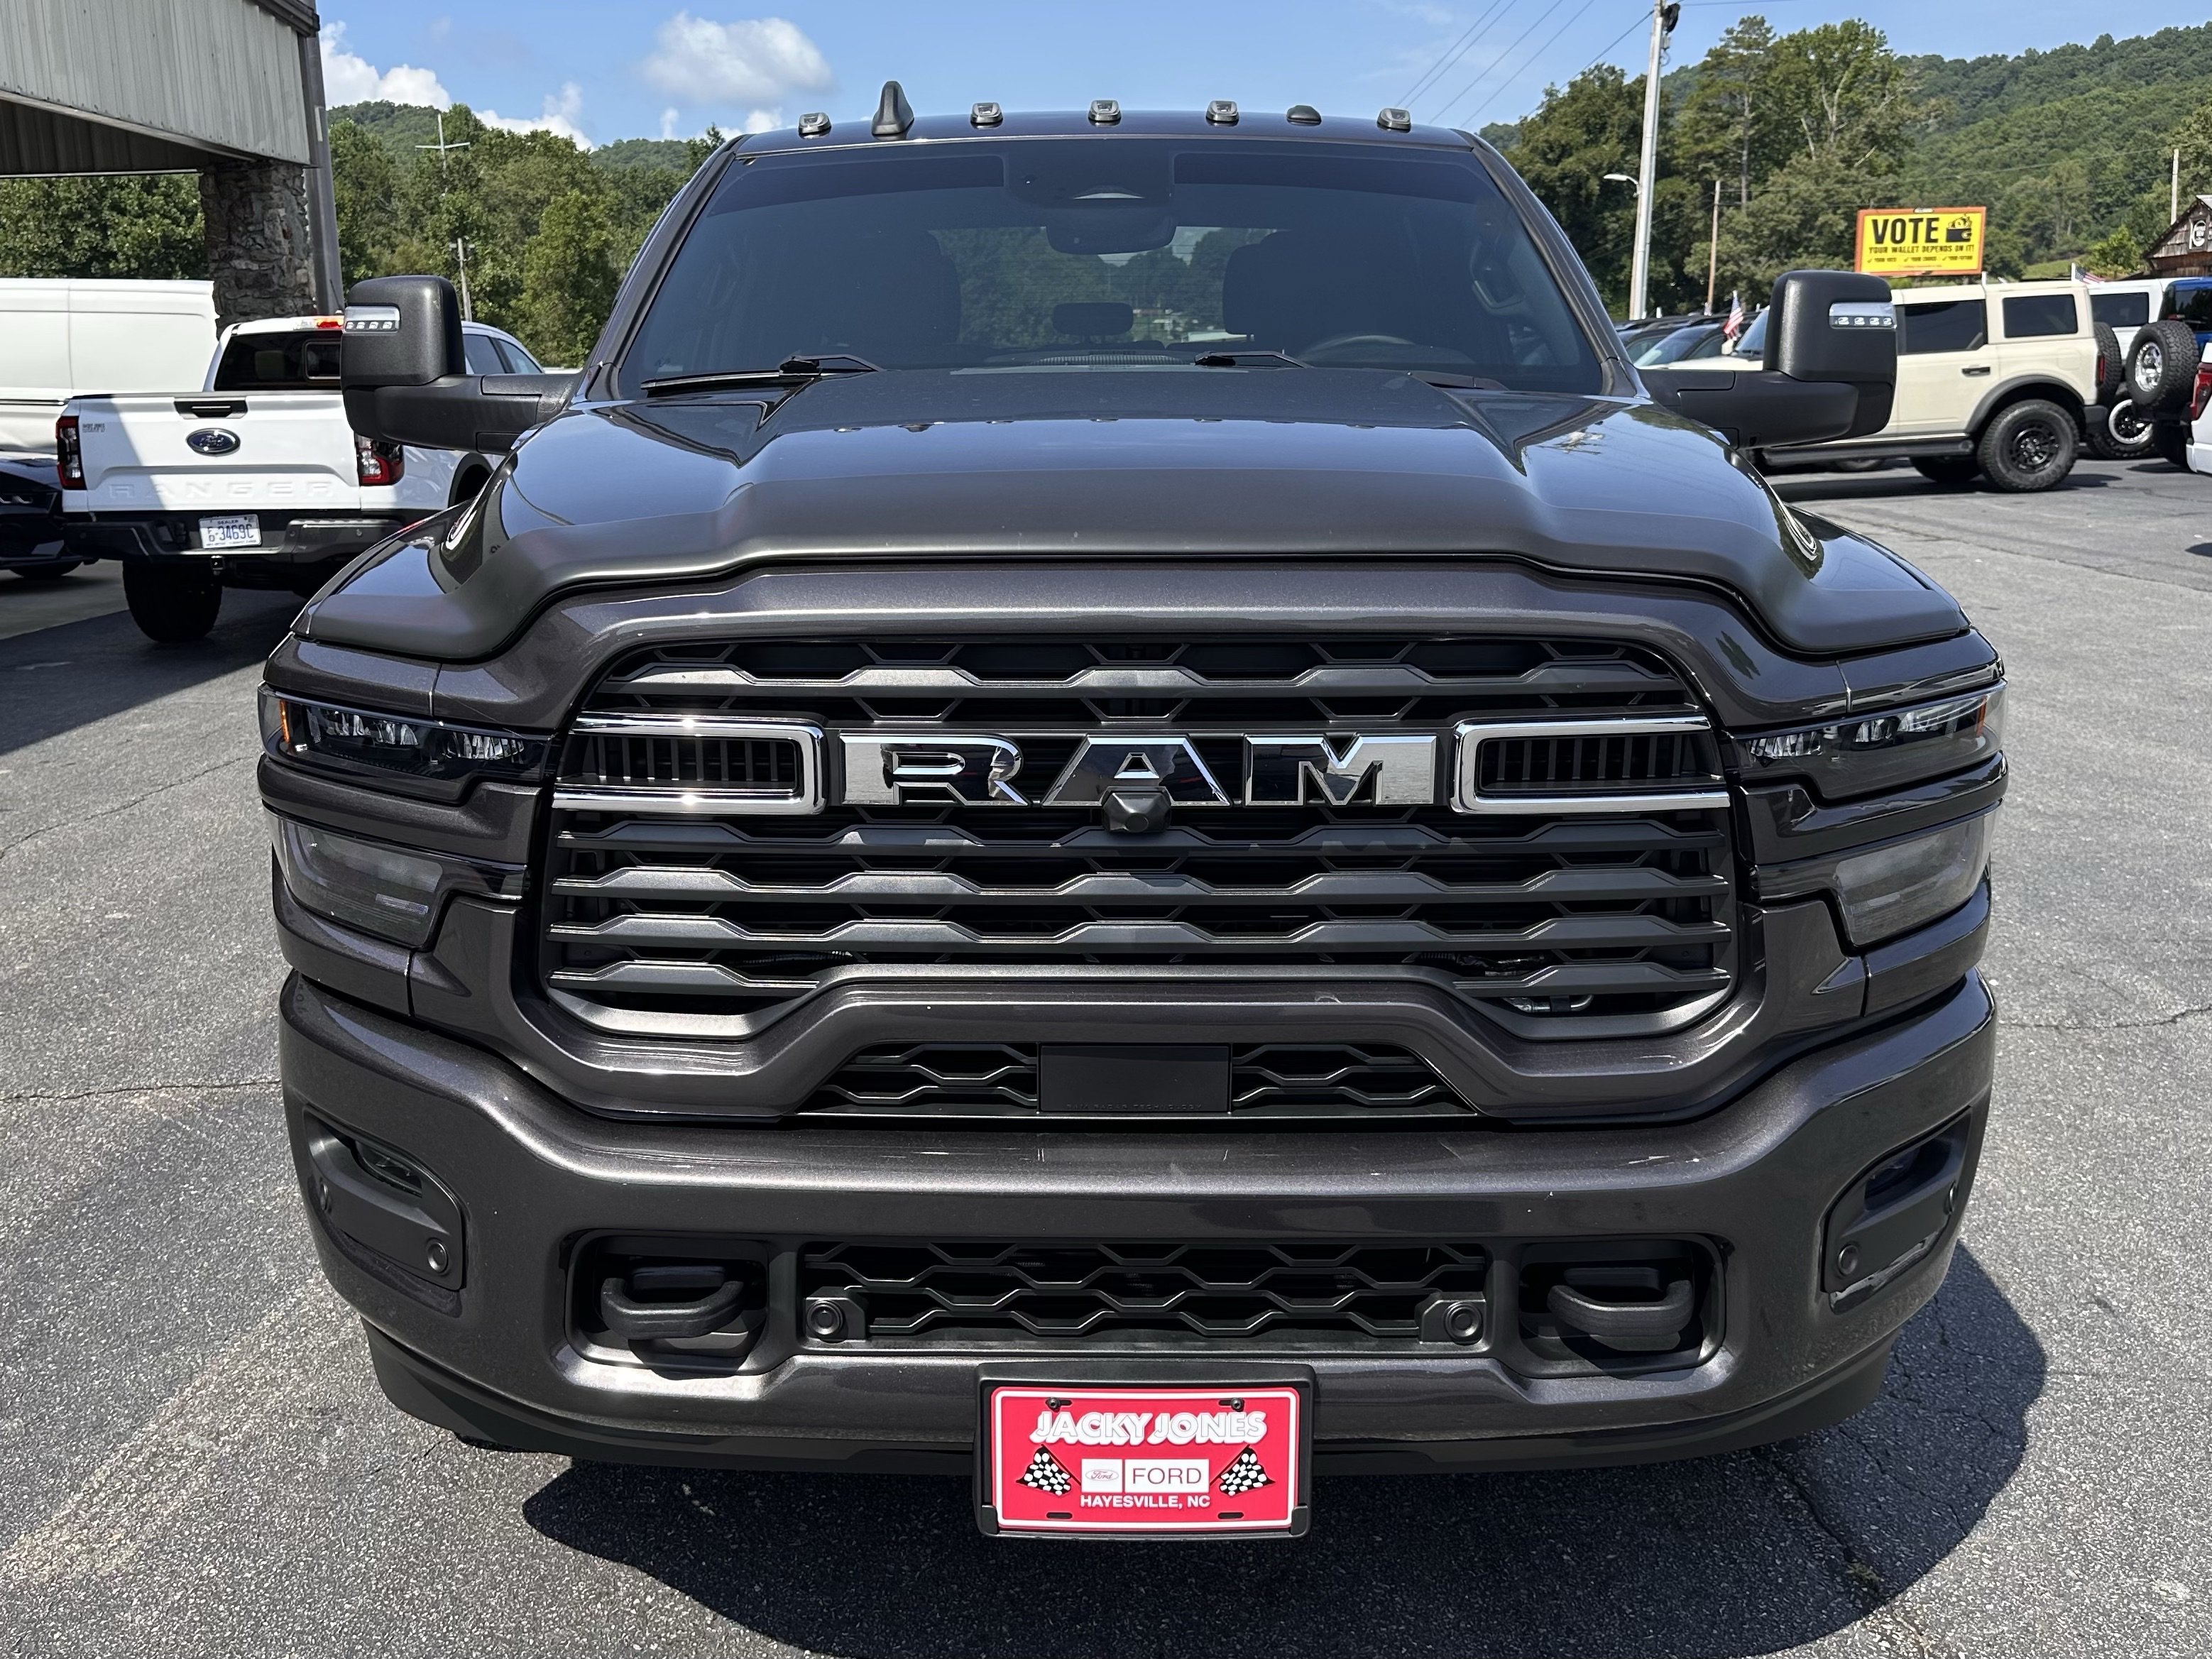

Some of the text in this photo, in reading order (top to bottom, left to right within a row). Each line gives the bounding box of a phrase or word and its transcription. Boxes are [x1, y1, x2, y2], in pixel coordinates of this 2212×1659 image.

[1871, 217, 1939, 244] VOTE
[109, 481, 334, 498] RANGER
[839, 733, 1438, 806] RAM
[1030, 1411, 1267, 1445] JACKY JONES
[1090, 1467, 1202, 1484] Ford FORD
[1080, 1495, 1210, 1509] HAYESVILLE, NC
